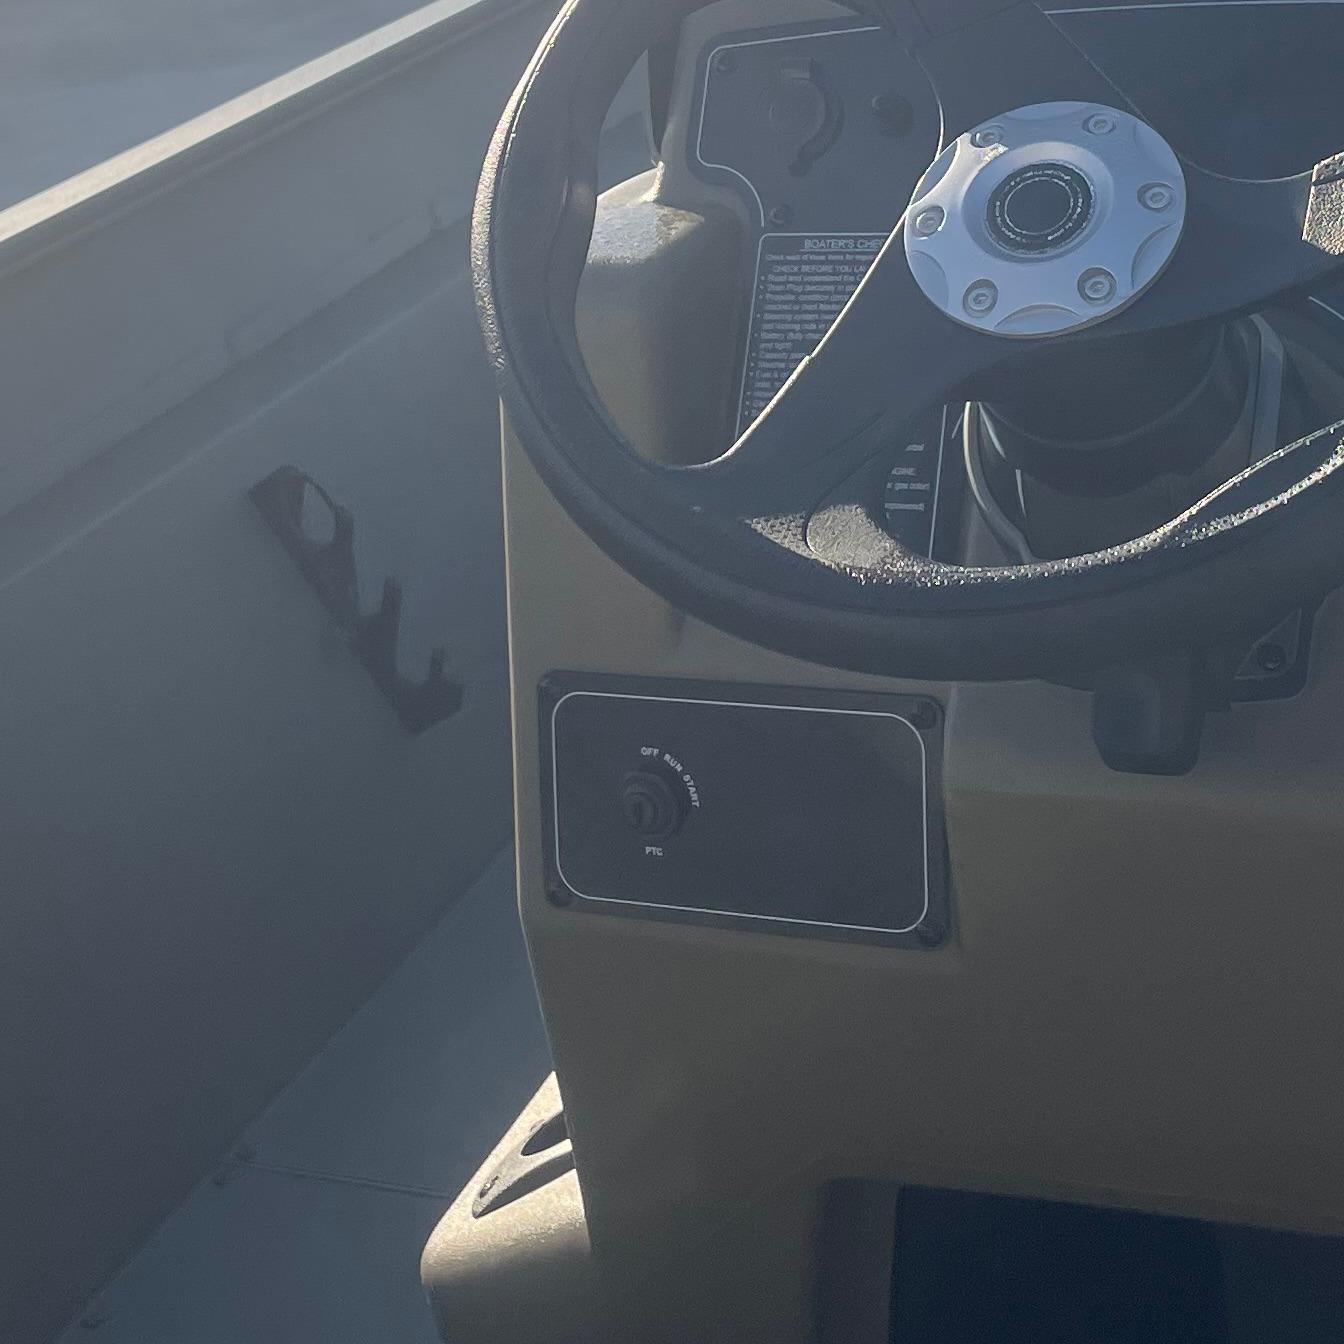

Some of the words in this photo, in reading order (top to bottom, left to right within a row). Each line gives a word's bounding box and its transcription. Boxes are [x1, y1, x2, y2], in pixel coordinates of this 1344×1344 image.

[804, 238, 855, 249] BOATER'S
[773, 265, 799, 273] CHECK
[801, 265, 833, 273] BEFORE
[835, 265, 853, 273] YOU
[640, 746, 659, 757] OFF
[663, 753, 683, 772] RUN
[683, 774, 700, 808] START
